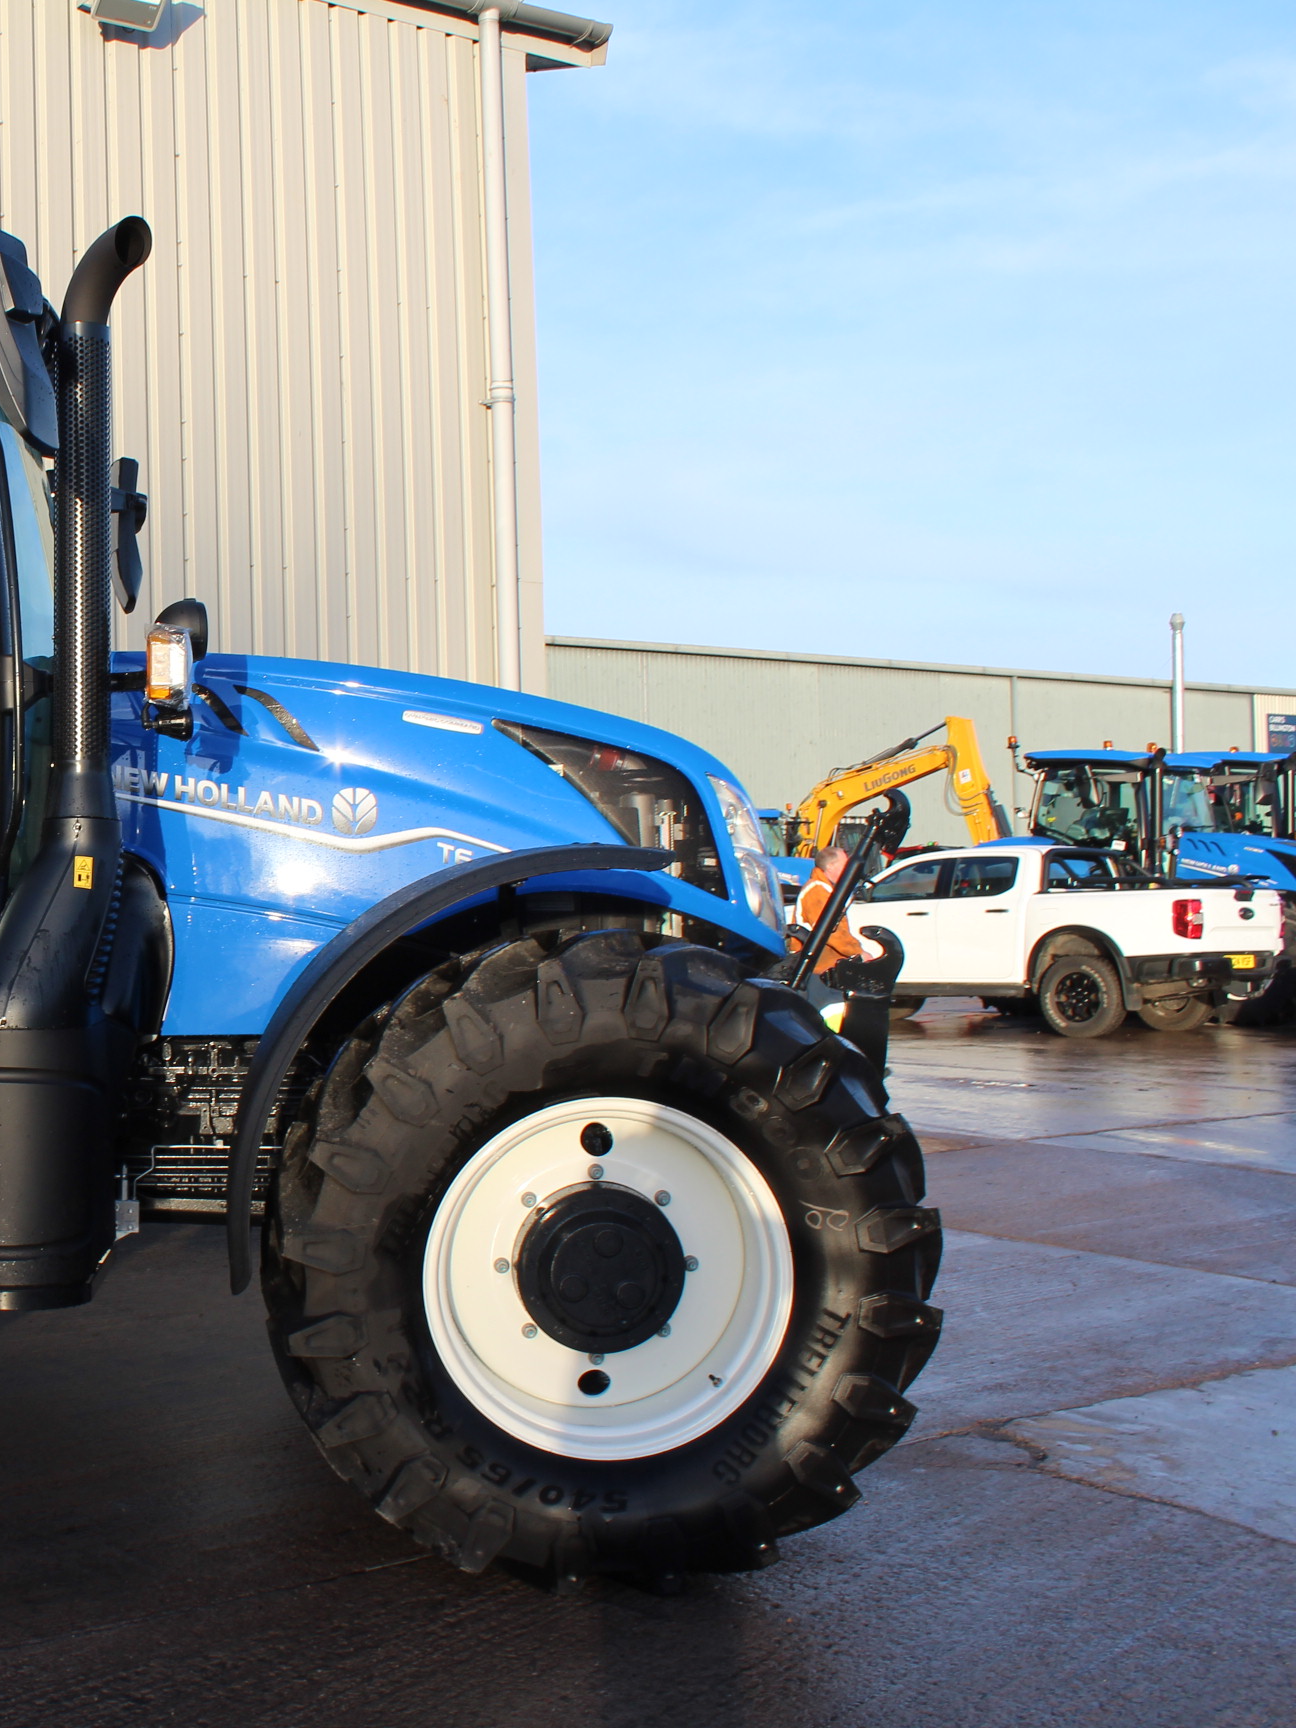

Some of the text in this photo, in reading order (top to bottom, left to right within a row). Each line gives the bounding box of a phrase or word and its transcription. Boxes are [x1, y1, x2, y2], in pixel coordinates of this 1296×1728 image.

[111, 764, 323, 826] NEW HOLLAND
[711, 1307, 852, 1487] TRELLEBORG
